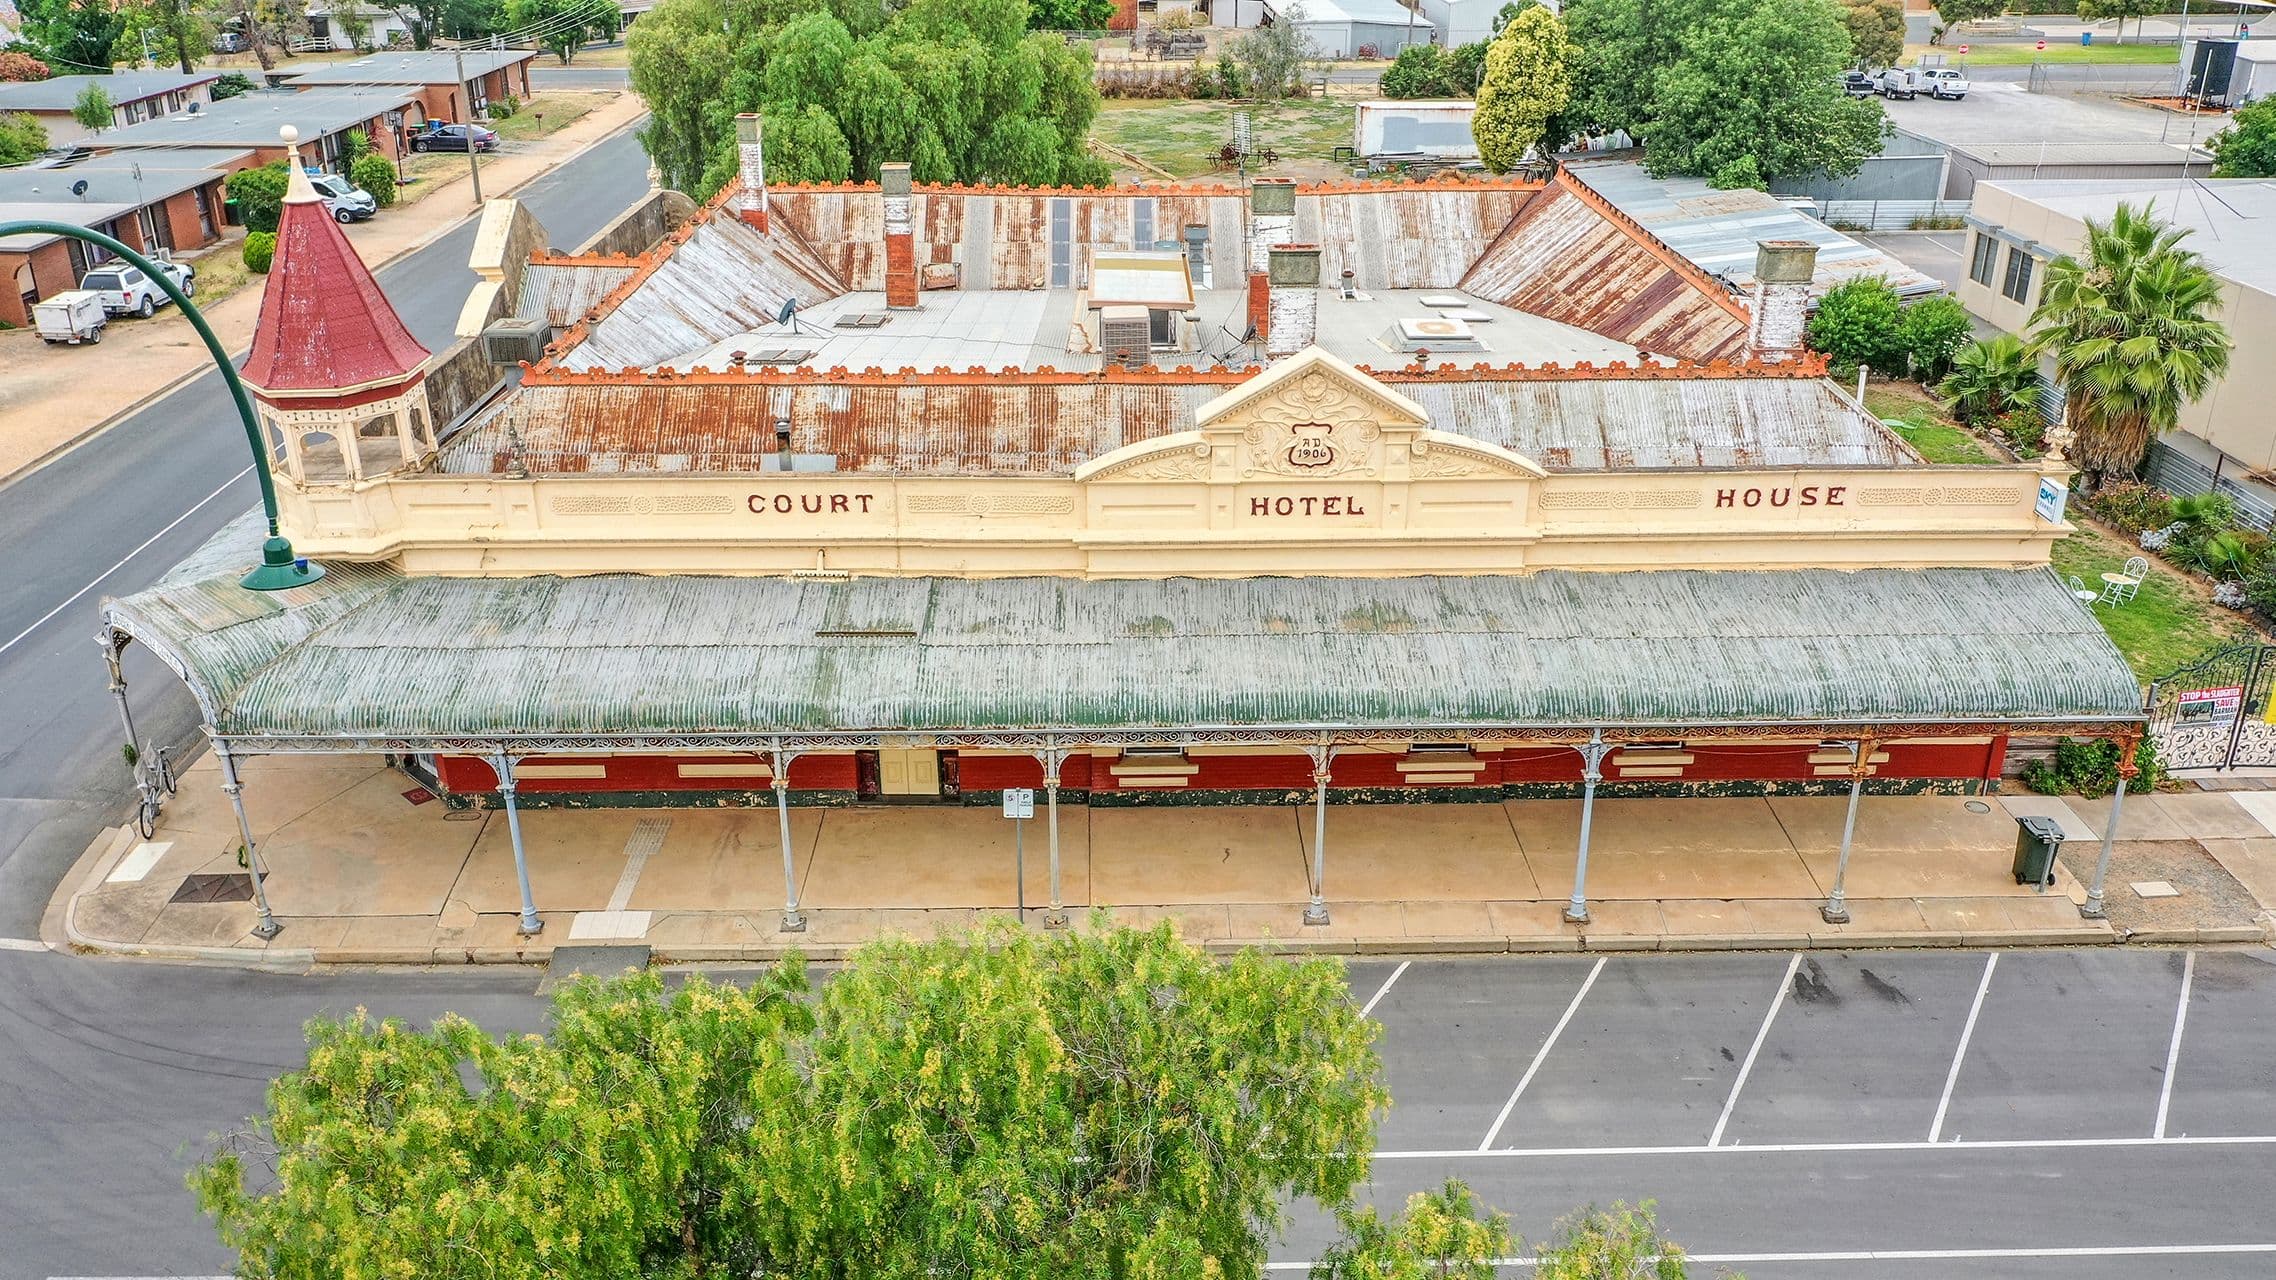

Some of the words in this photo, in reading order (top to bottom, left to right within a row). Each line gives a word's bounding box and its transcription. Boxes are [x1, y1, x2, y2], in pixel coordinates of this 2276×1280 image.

[1298, 448, 1327, 459] 1906
[747, 494, 873, 514] COURT
[1715, 486, 1847, 508] HOUSE
[1250, 495, 1365, 516] HOTEL
[2181, 691, 2201, 701] STOP
[2215, 699, 2234, 708] SAVE
